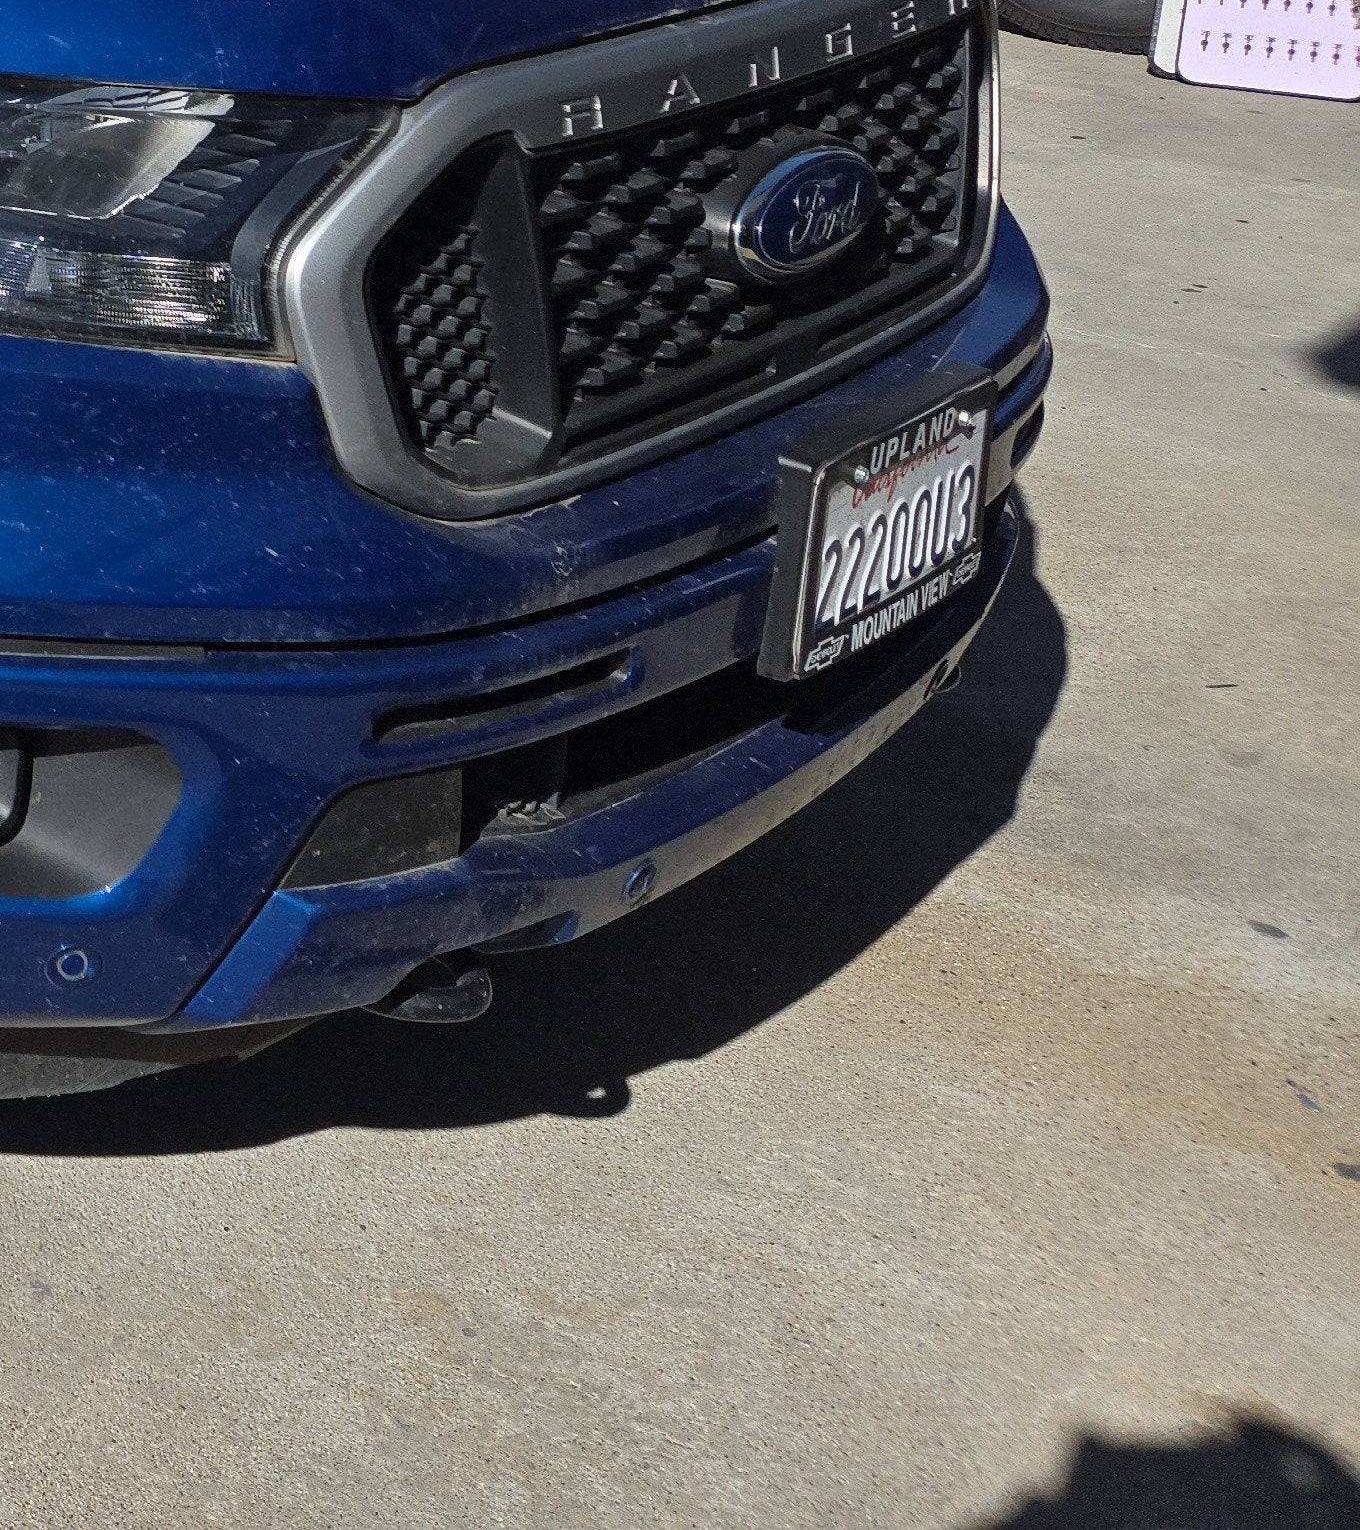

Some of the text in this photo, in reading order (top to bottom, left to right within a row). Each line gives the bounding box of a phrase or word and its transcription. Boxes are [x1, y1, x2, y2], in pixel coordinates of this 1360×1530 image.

[788, 174, 861, 254] Ford
[870, 407, 956, 474] UPLAND
[850, 591, 919, 652] MOUNTAIN
[920, 570, 950, 613] VIEW
